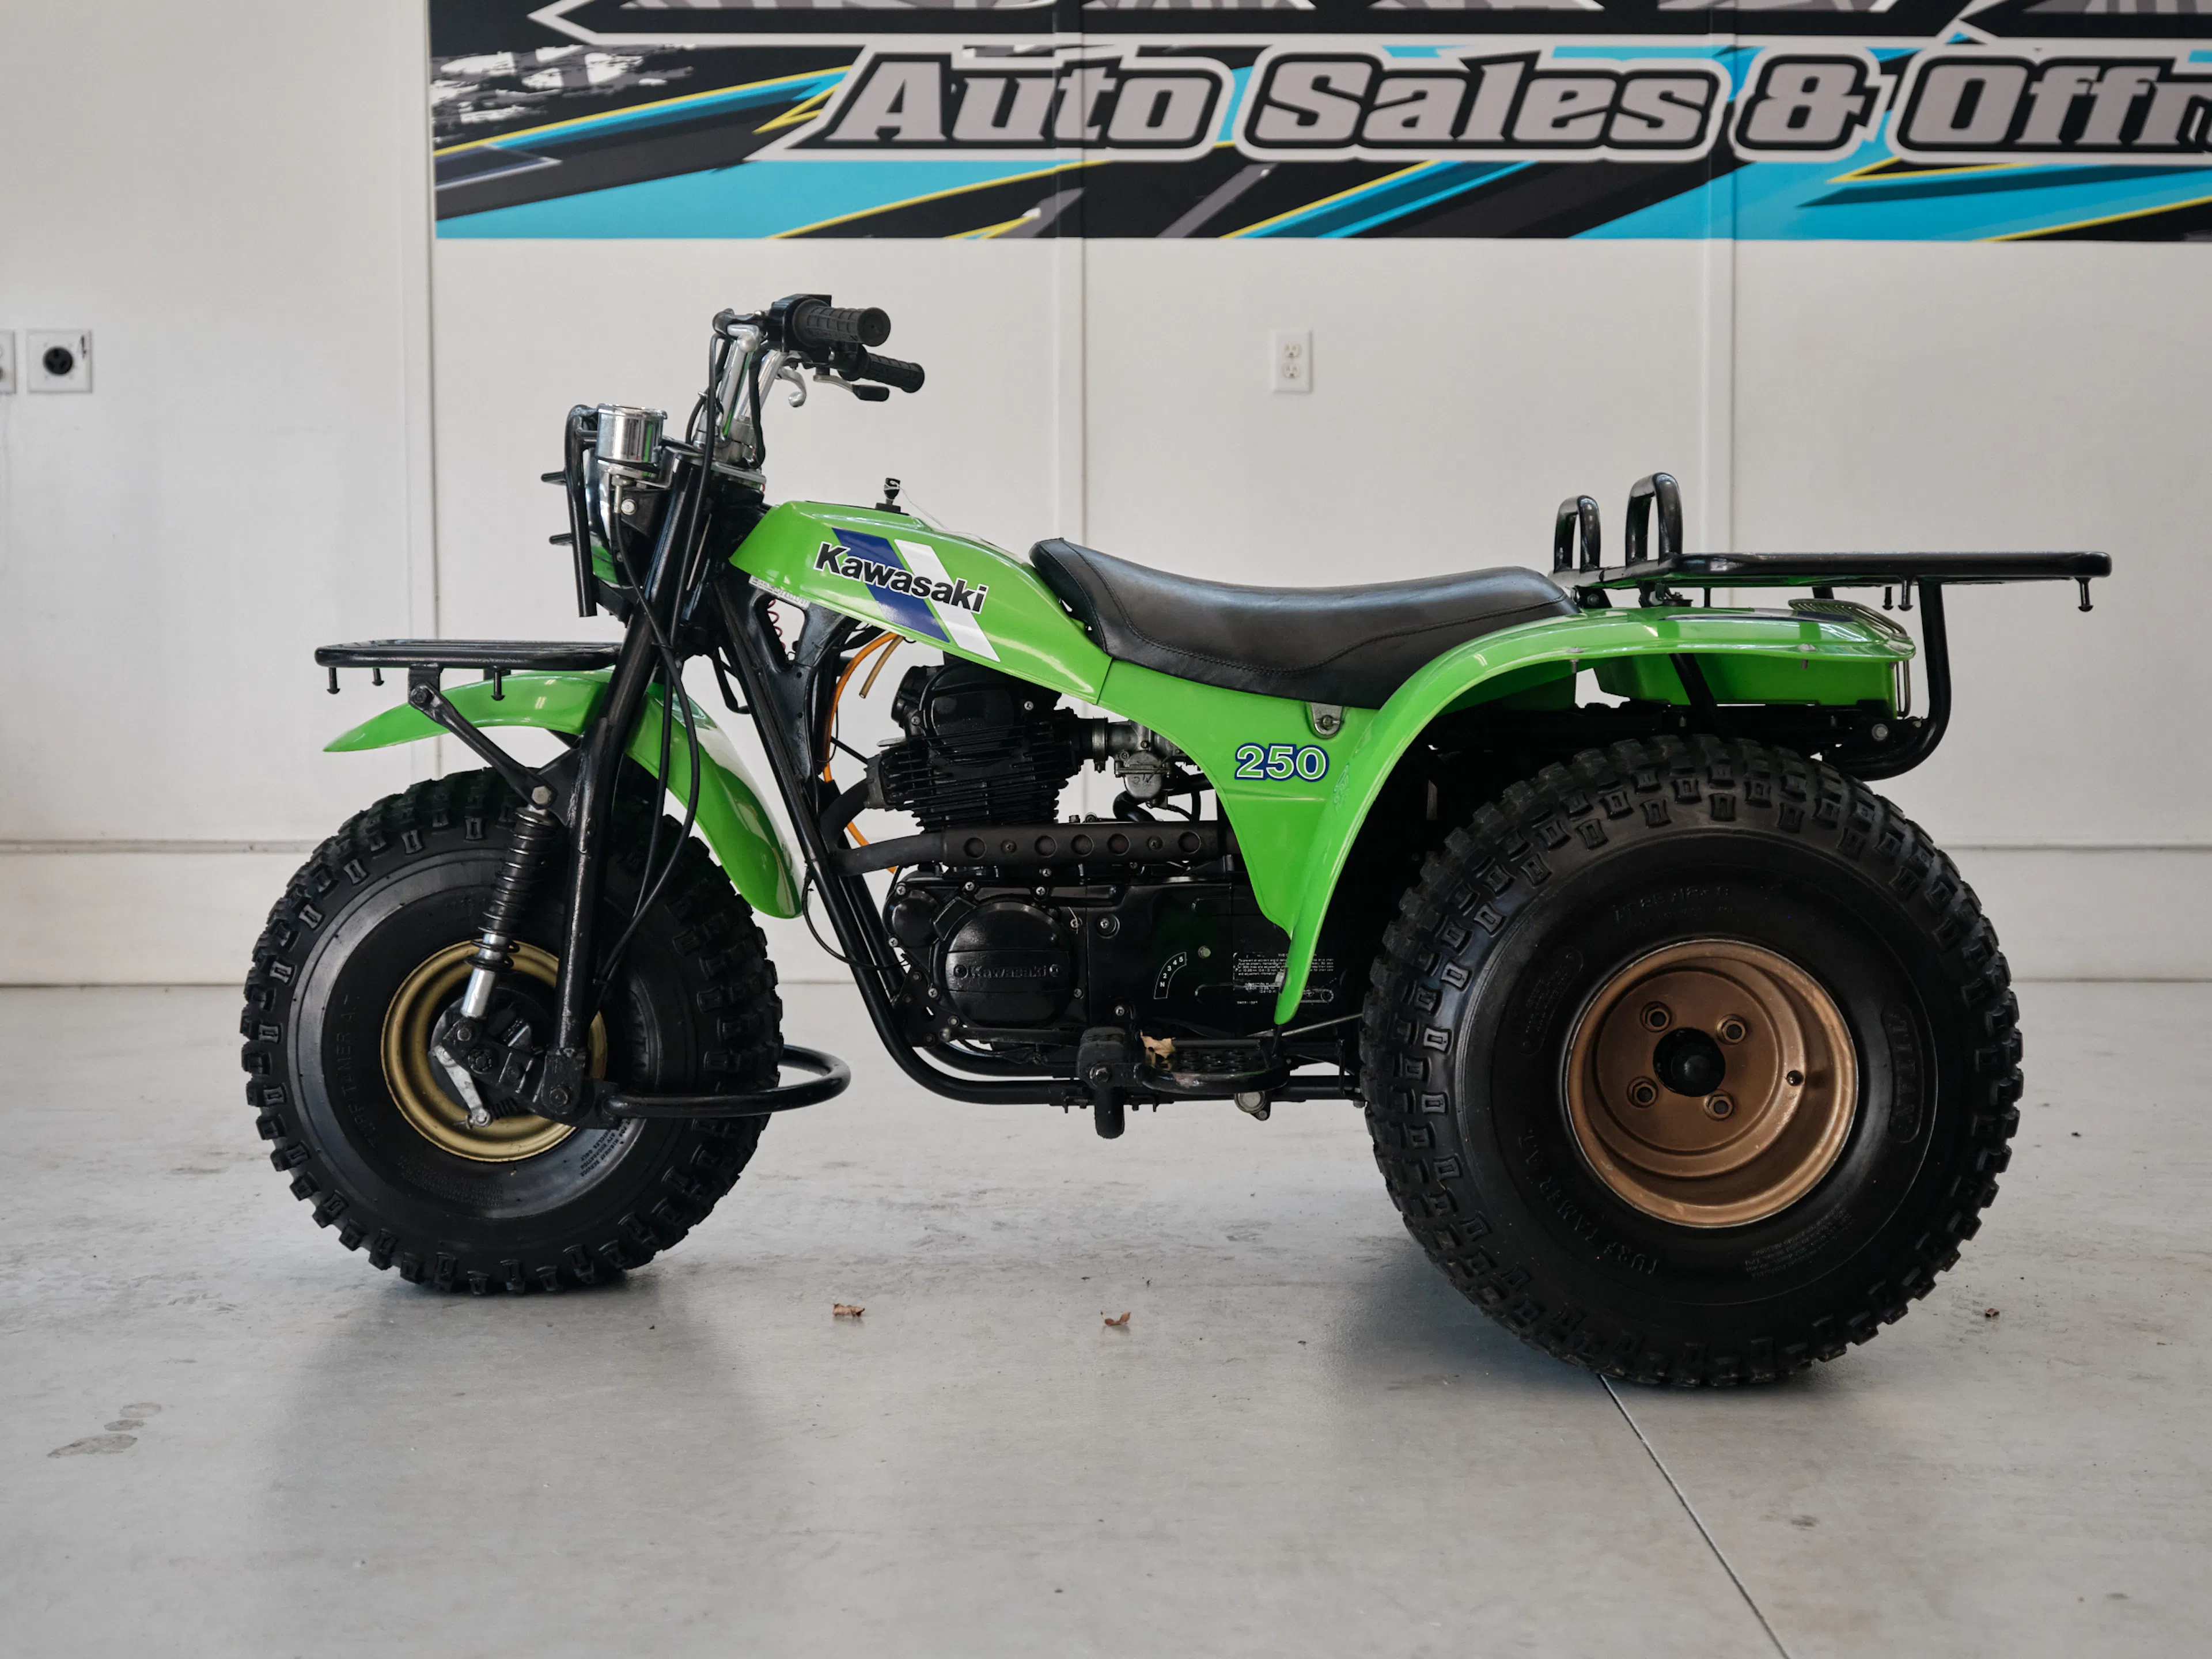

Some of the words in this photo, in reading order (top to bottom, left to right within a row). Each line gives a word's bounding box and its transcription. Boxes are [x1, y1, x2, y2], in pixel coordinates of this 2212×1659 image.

[823, 59, 1205, 143] Auto
[1262, 59, 1711, 143] Sales
[1743, 61, 1865, 143] &
[1905, 63, 2212, 145] Offr
[814, 541, 989, 613] Kawasaki
[1235, 743, 1328, 781] 250
[968, 964, 1047, 979] Kawasaki
[599, 1137, 620, 1161] HIGHWAY
